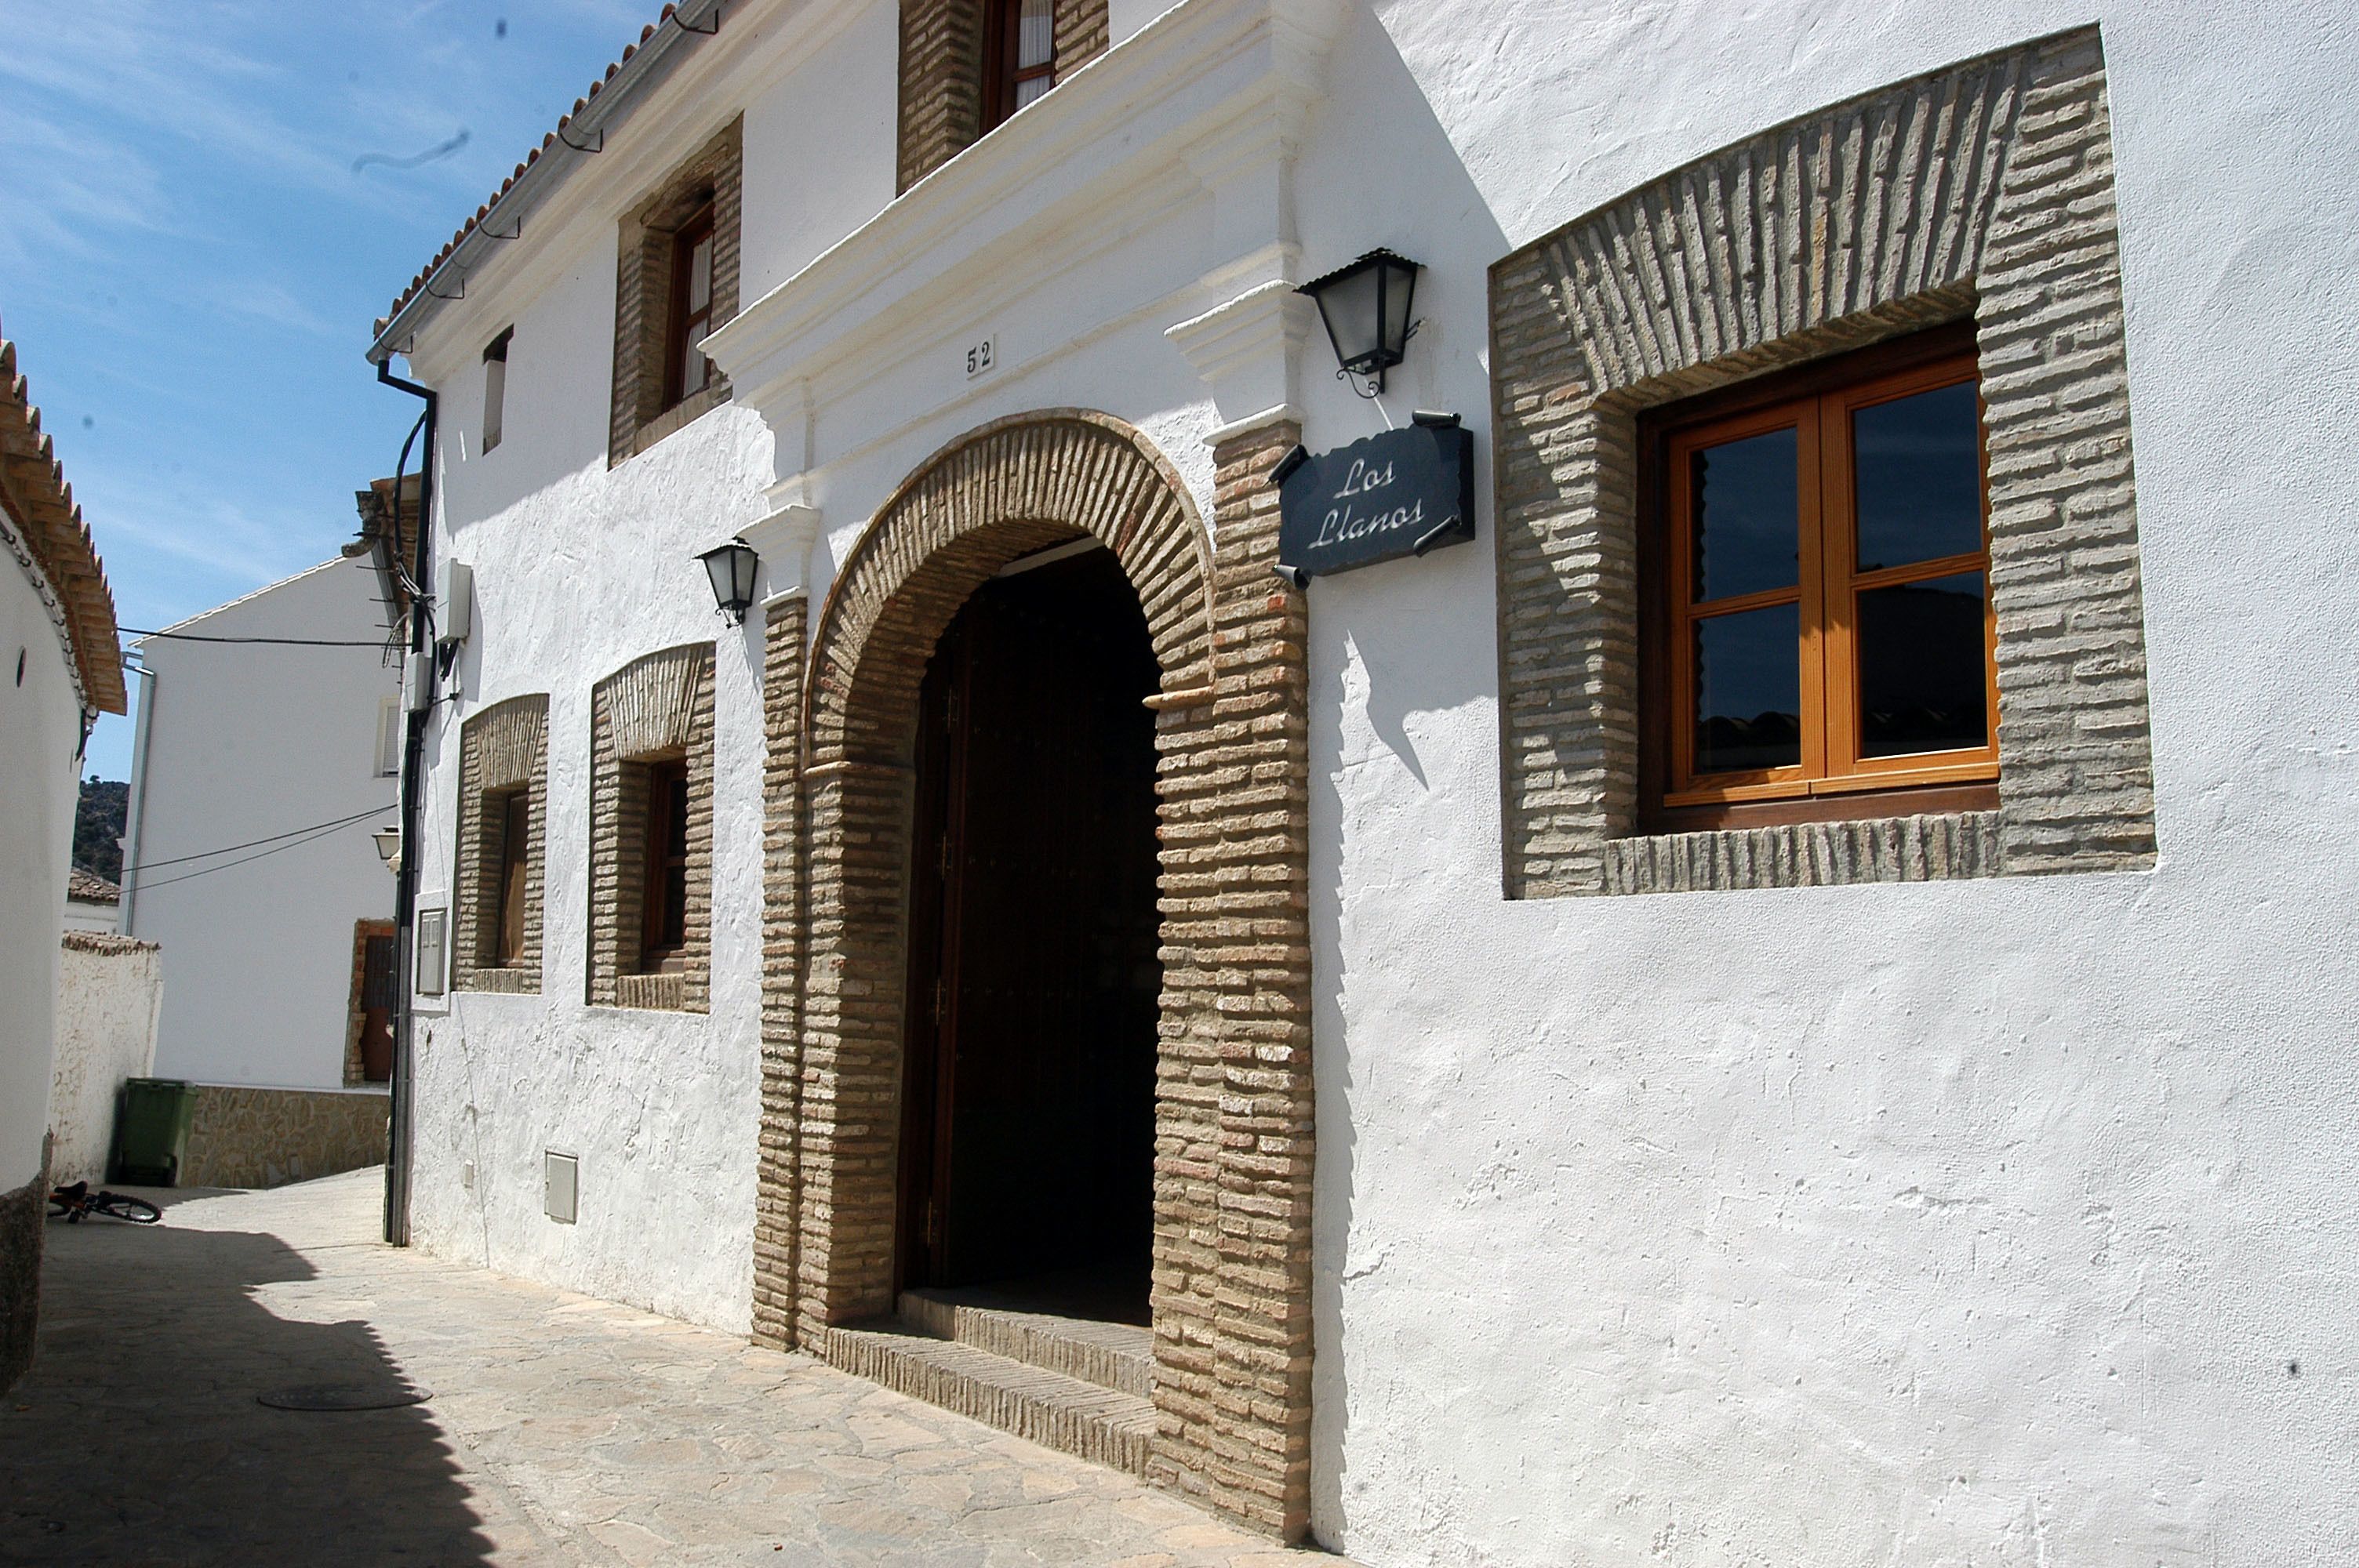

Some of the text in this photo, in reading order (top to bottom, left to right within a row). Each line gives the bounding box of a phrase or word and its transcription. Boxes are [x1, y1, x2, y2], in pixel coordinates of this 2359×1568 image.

[967, 341, 990, 373] 52
[1333, 458, 1396, 499] Los
[1307, 498, 1425, 549] Llanos
